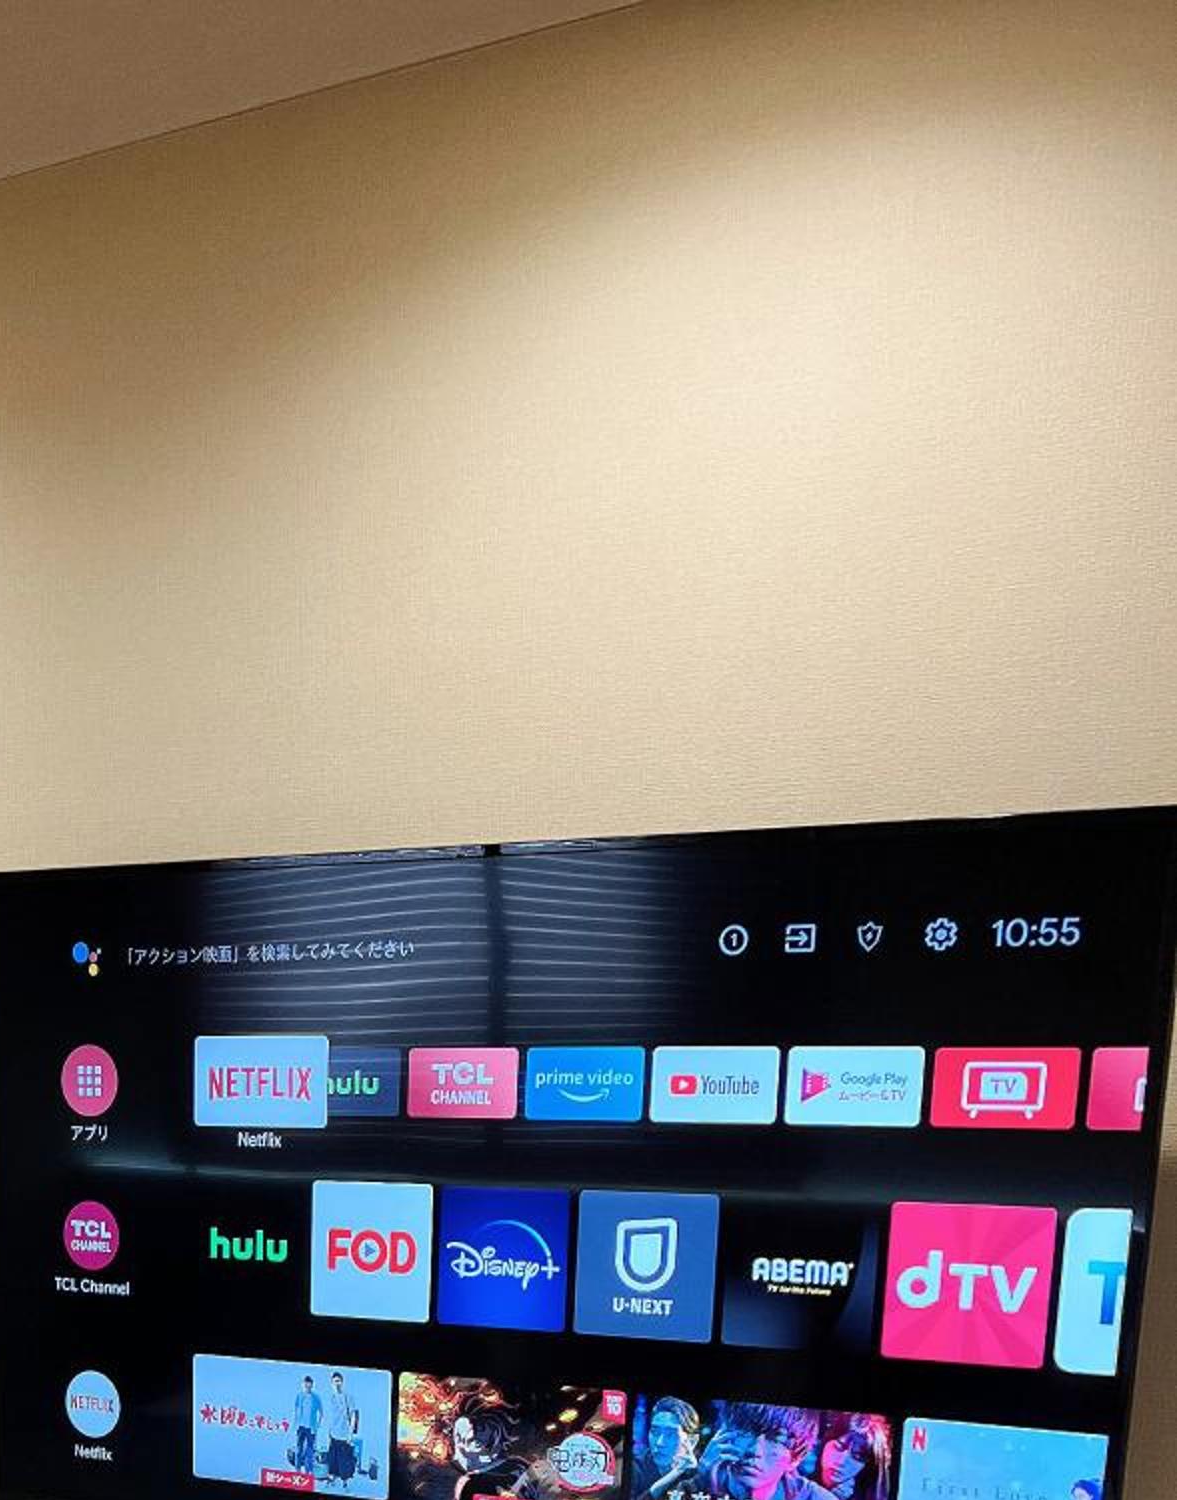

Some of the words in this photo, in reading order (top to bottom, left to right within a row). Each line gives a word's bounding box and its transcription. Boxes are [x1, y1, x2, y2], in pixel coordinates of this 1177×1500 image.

[991, 917, 1082, 948] 10:55
[208, 1066, 312, 1101] NETFLIX
[431, 1061, 495, 1086] TCL
[535, 1069, 584, 1089] prime
[587, 1069, 635, 1086] video
[841, 1072, 882, 1087] Google
[884, 1072, 908, 1088] Play
[700, 1074, 760, 1096] YouTube
[991, 1077, 1018, 1095] TV
[430, 1089, 492, 1106] CHANNEL
[70, 1125, 110, 1142] アプリ
[237, 1131, 282, 1148] Netflix
[71, 1220, 112, 1239] TCL
[209, 1227, 288, 1263] hulu
[327, 1228, 417, 1275] FOD
[751, 1257, 851, 1287] ABEMA
[54, 1276, 79, 1292] TCL
[80, 1279, 130, 1296] Channel
[895, 1250, 1037, 1315] dTV
[613, 1297, 674, 1316] U-NEXT
[74, 1443, 114, 1461] Netflix
